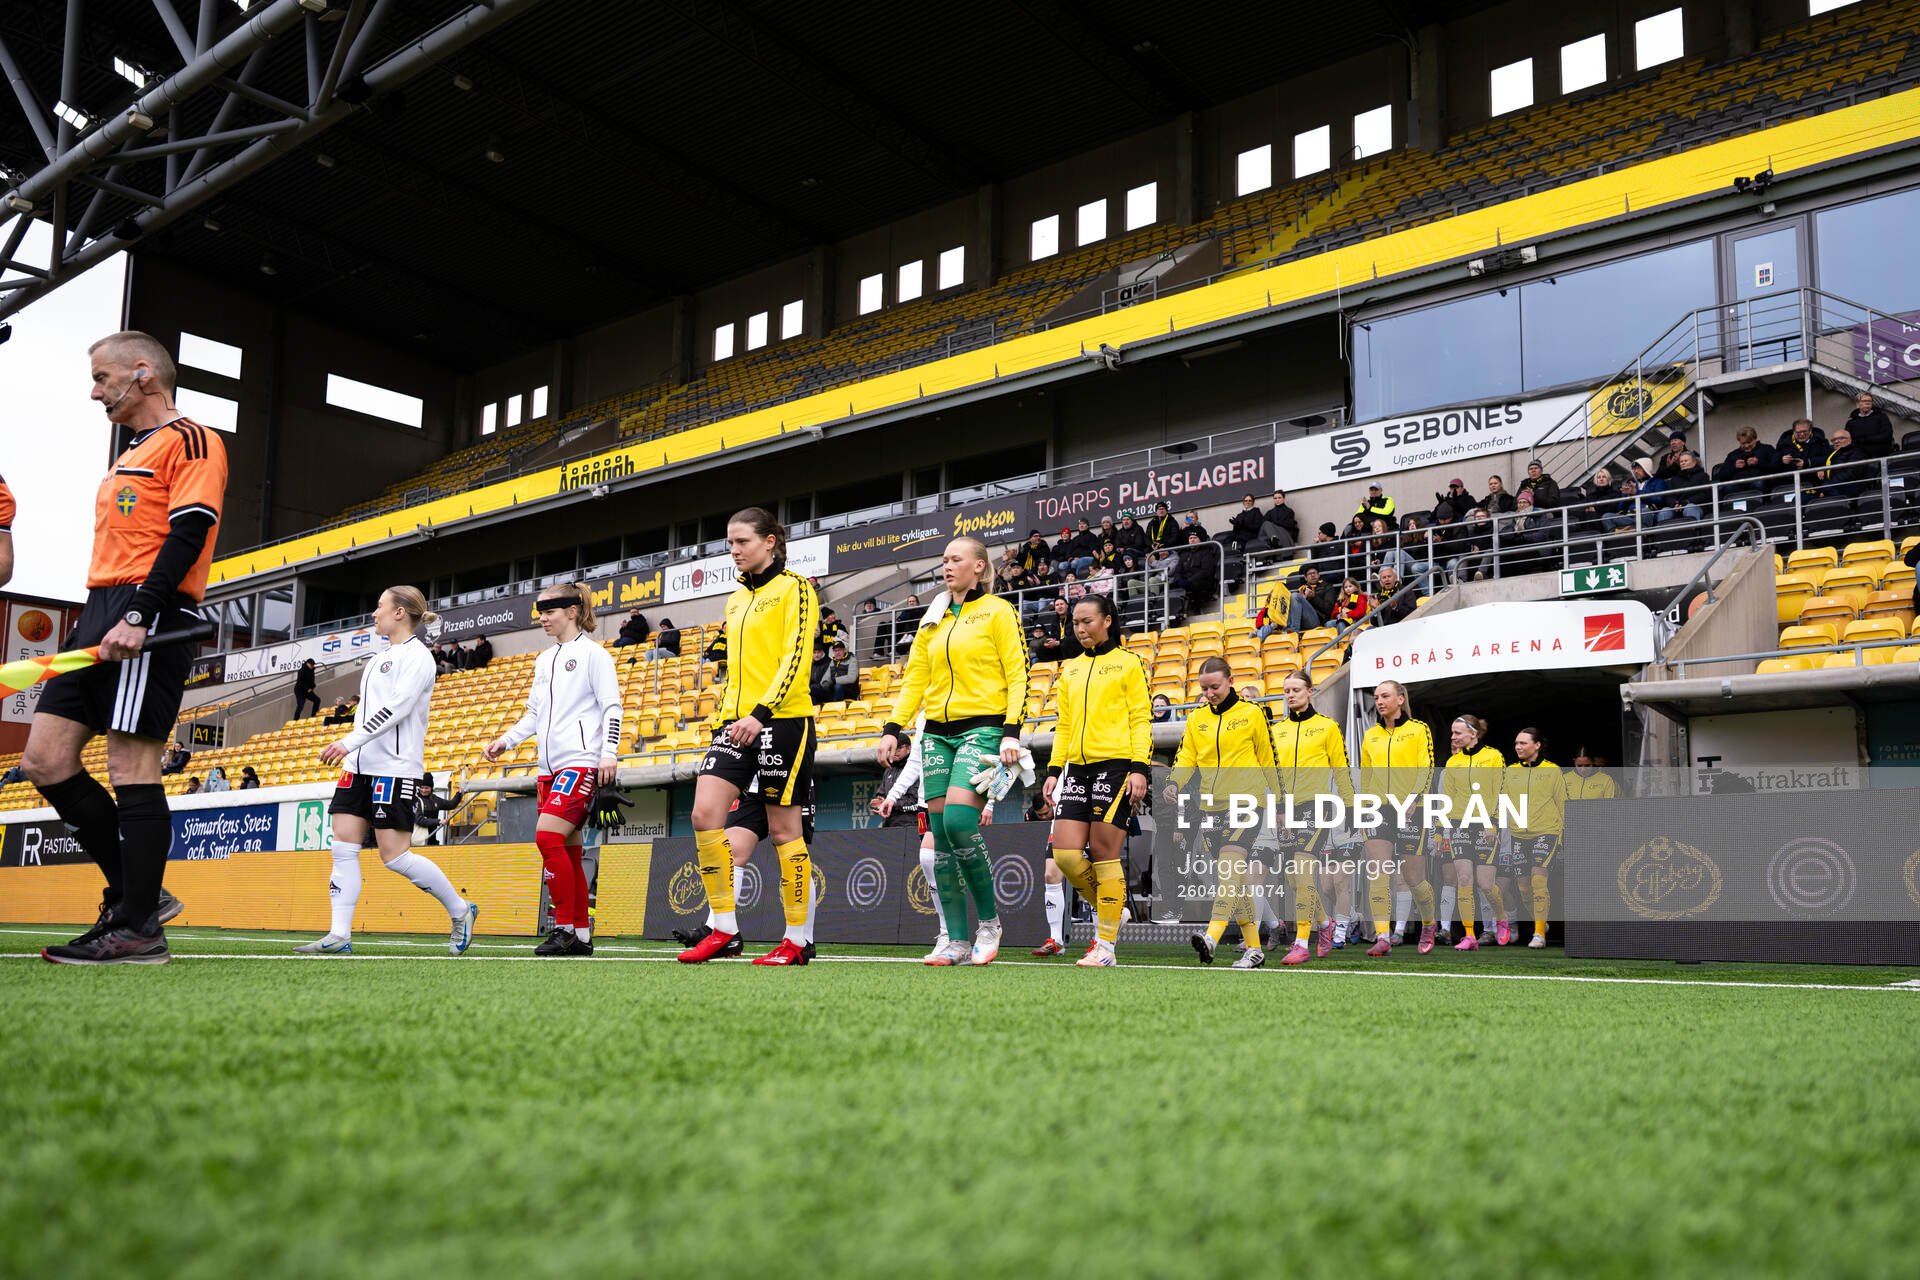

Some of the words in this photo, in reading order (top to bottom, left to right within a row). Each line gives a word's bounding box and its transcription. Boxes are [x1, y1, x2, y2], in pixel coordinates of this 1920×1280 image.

[1393, 449, 1439, 468] Upgrade
[1440, 443, 1465, 457] with
[1467, 435, 1513, 451] comfort
[1035, 487, 1111, 520] TOARPS
[1119, 456, 1265, 505] PLÅTSLAGERI
[953, 509, 1016, 537] Sportson
[836, 544, 851, 554] När
[851, 540, 862, 551] du
[863, 538, 875, 549] vill
[876, 536, 886, 547] bli
[887, 534, 900, 544] lite
[901, 526, 940, 543] cykligare.
[802, 553, 816, 564] Asia
[444, 616, 474, 633] Pizzeria
[477, 610, 514, 628] Granada
[1375, 647, 1454, 670] BORÅS
[1472, 637, 1563, 657] ARENA
[227, 672, 238, 681] PRO
[239, 669, 255, 679] SOCK
[280, 662, 291, 671] PRO
[194, 727, 209, 742] A1
[700, 757, 717, 771] 13
[181, 813, 240, 845] Sjömarkens
[240, 813, 273, 835] Svets
[187, 839, 205, 861] och
